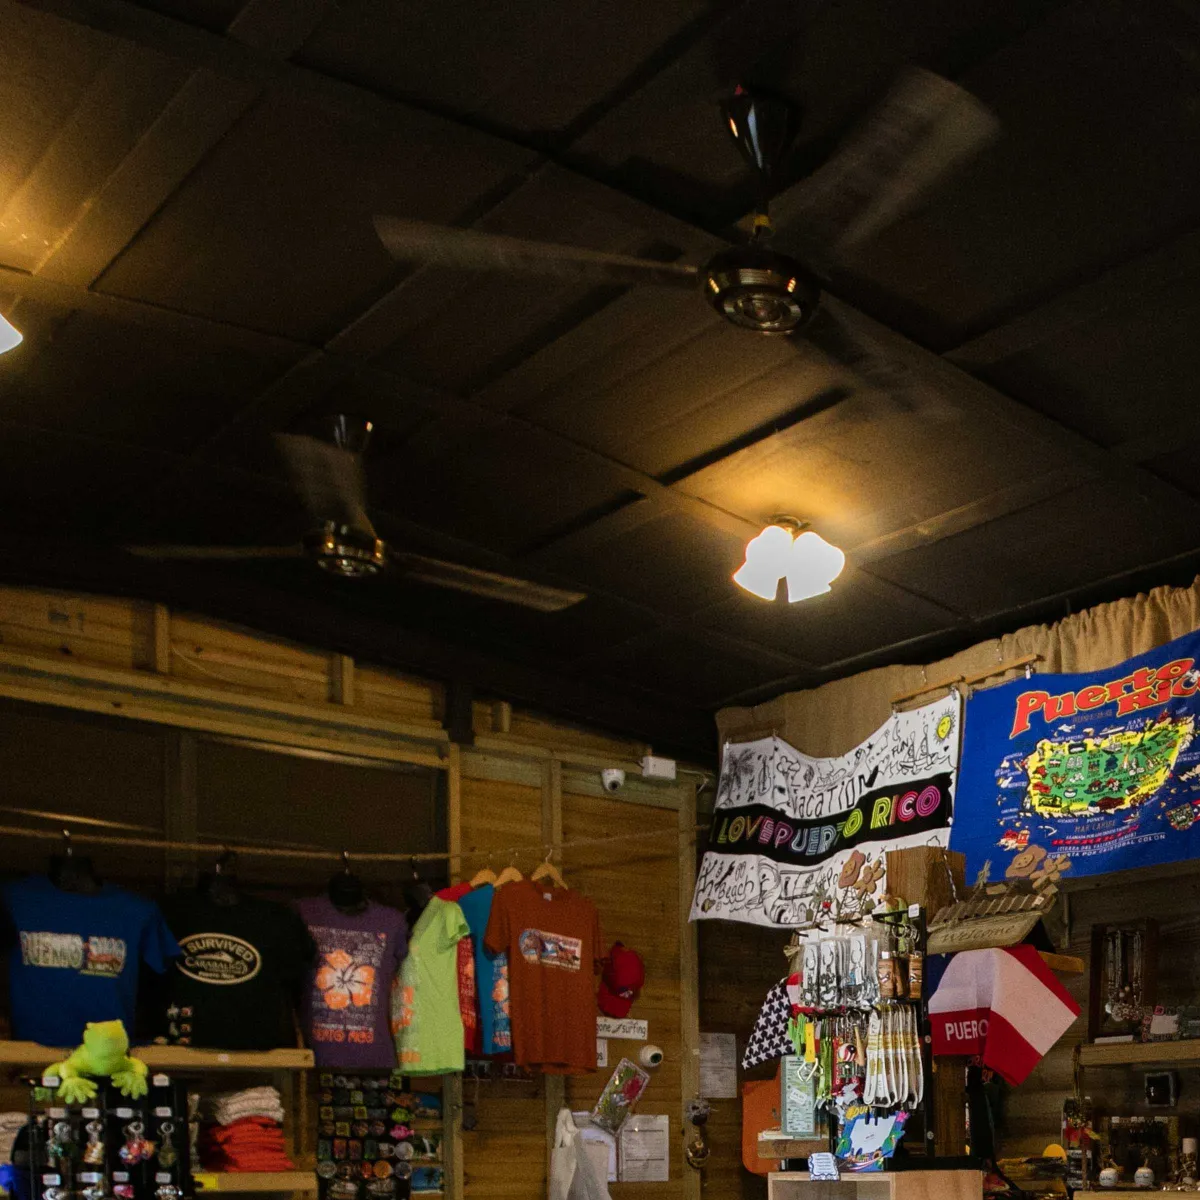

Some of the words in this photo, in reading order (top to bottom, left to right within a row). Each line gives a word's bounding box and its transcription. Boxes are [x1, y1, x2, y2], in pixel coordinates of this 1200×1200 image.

[1009, 658, 1195, 739] Puerto
[891, 739, 909, 757] FUN
[717, 814, 775, 844] LOVE
[870, 785, 941, 829] RICO
[1137, 834, 1166, 844] COLON
[186, 936, 255, 962] SURVIVED
[621, 1021, 647, 1037] surfing
